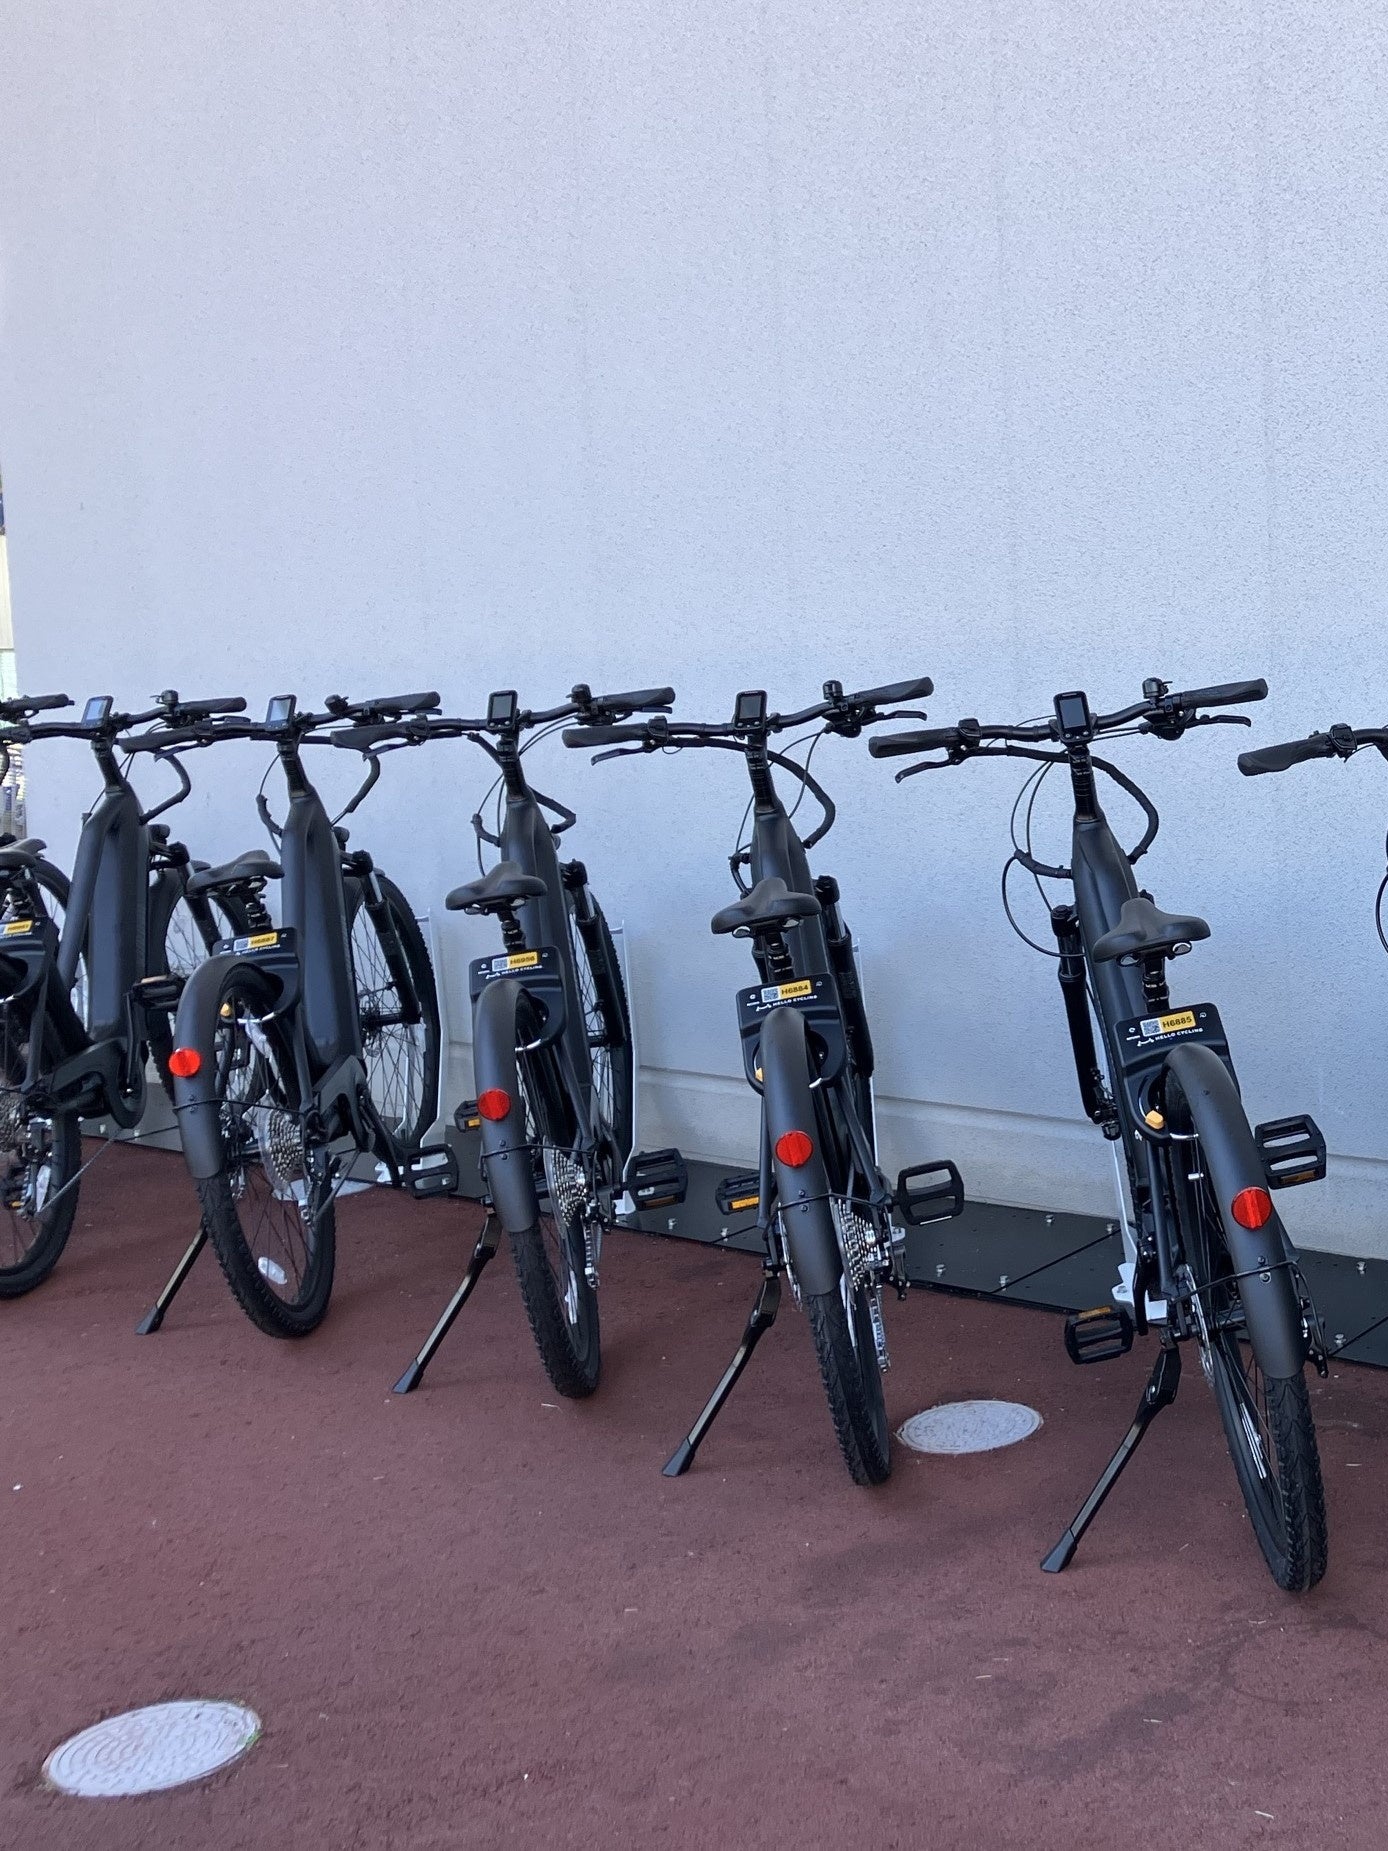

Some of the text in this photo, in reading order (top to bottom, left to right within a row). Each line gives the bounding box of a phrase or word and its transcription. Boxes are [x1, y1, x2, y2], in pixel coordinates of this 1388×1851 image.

[781, 984, 809, 995] H6884
[1161, 1015, 1193, 1029] H6885
[1154, 1027, 1204, 1041] HELLO CYCLING
